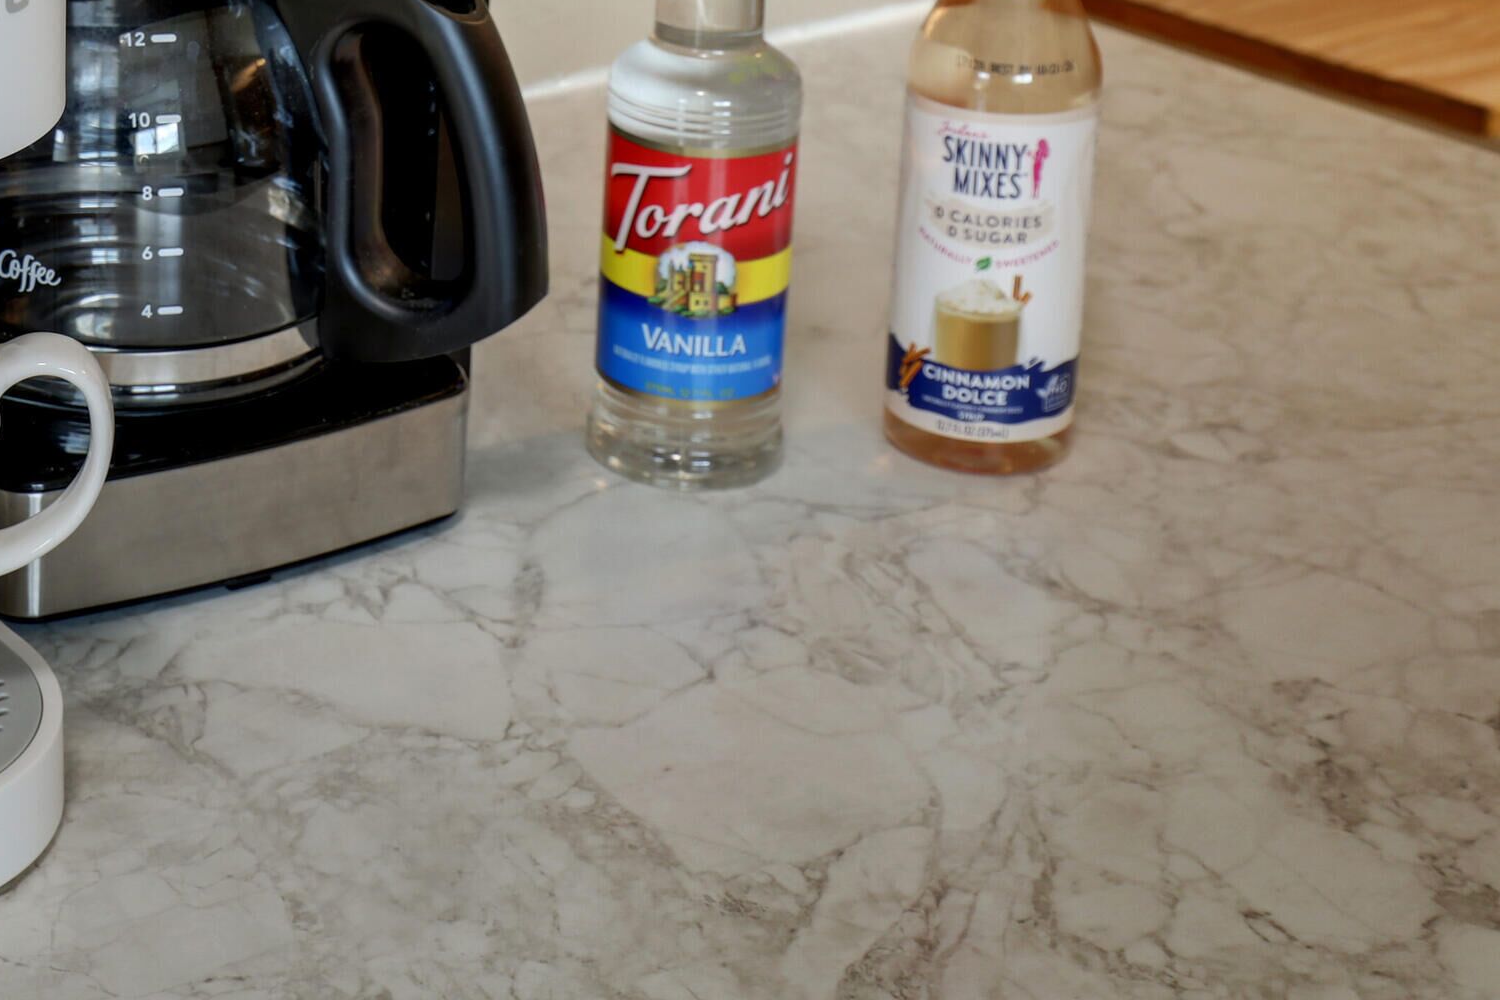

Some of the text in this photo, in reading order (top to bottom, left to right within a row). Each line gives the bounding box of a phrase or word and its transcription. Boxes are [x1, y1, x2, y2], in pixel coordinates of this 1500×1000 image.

[124, 32, 146, 48] 12
[128, 112, 151, 128] 10
[942, 134, 1028, 170] SKINNY
[141, 186, 153, 201] 8
[953, 167, 1022, 199] MIXES
[611, 152, 793, 254] Torani
[950, 209, 1043, 230] CALORIES
[964, 228, 1028, 244] SUGAR
[141, 246, 153, 260] 6
[140, 304, 153, 319] 4
[641, 323, 746, 358] VANILLA
[922, 363, 1030, 391] CINNAMON
[942, 384, 1009, 407] DOLCE
